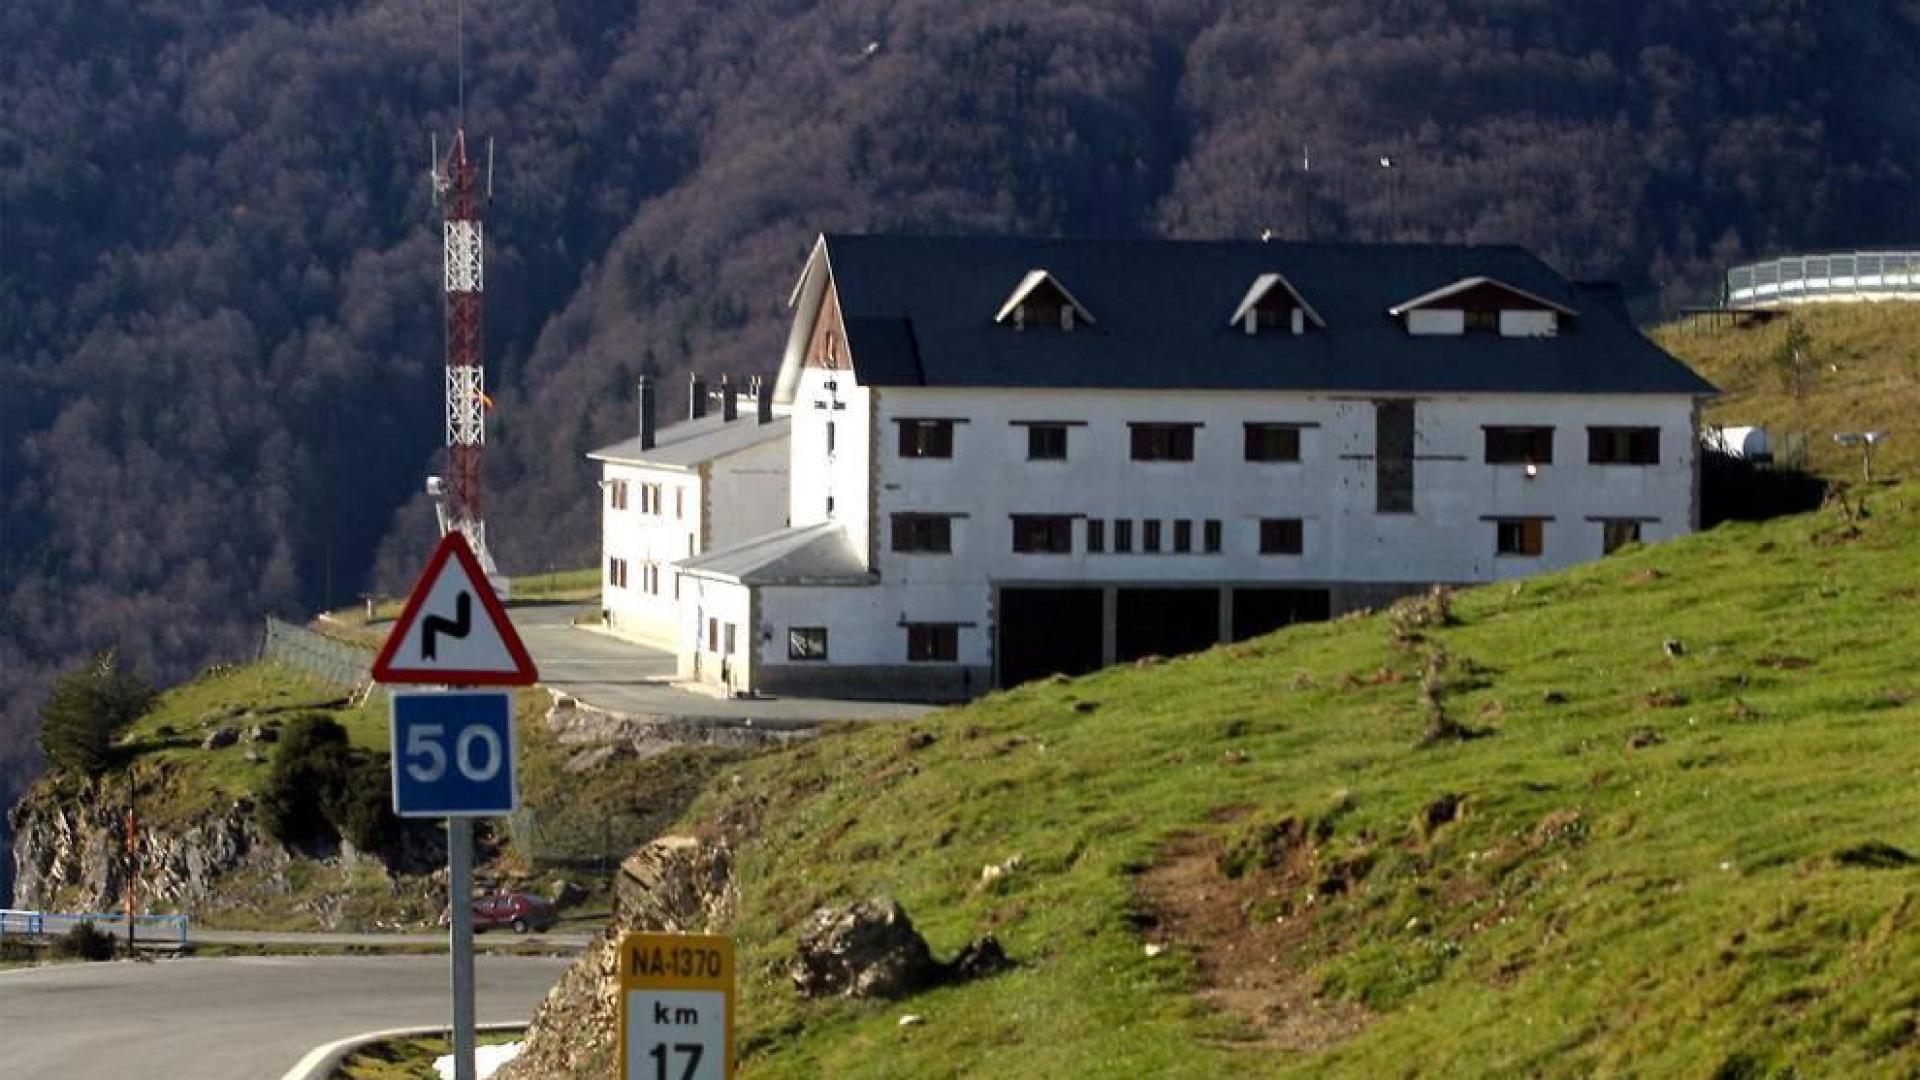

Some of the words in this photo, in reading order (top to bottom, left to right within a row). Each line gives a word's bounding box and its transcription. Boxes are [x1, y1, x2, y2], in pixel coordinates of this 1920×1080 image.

[406, 723, 503, 782] 50
[631, 946, 722, 977] NA-1370
[654, 1000, 699, 1025] km
[649, 1042, 704, 1080] 17
